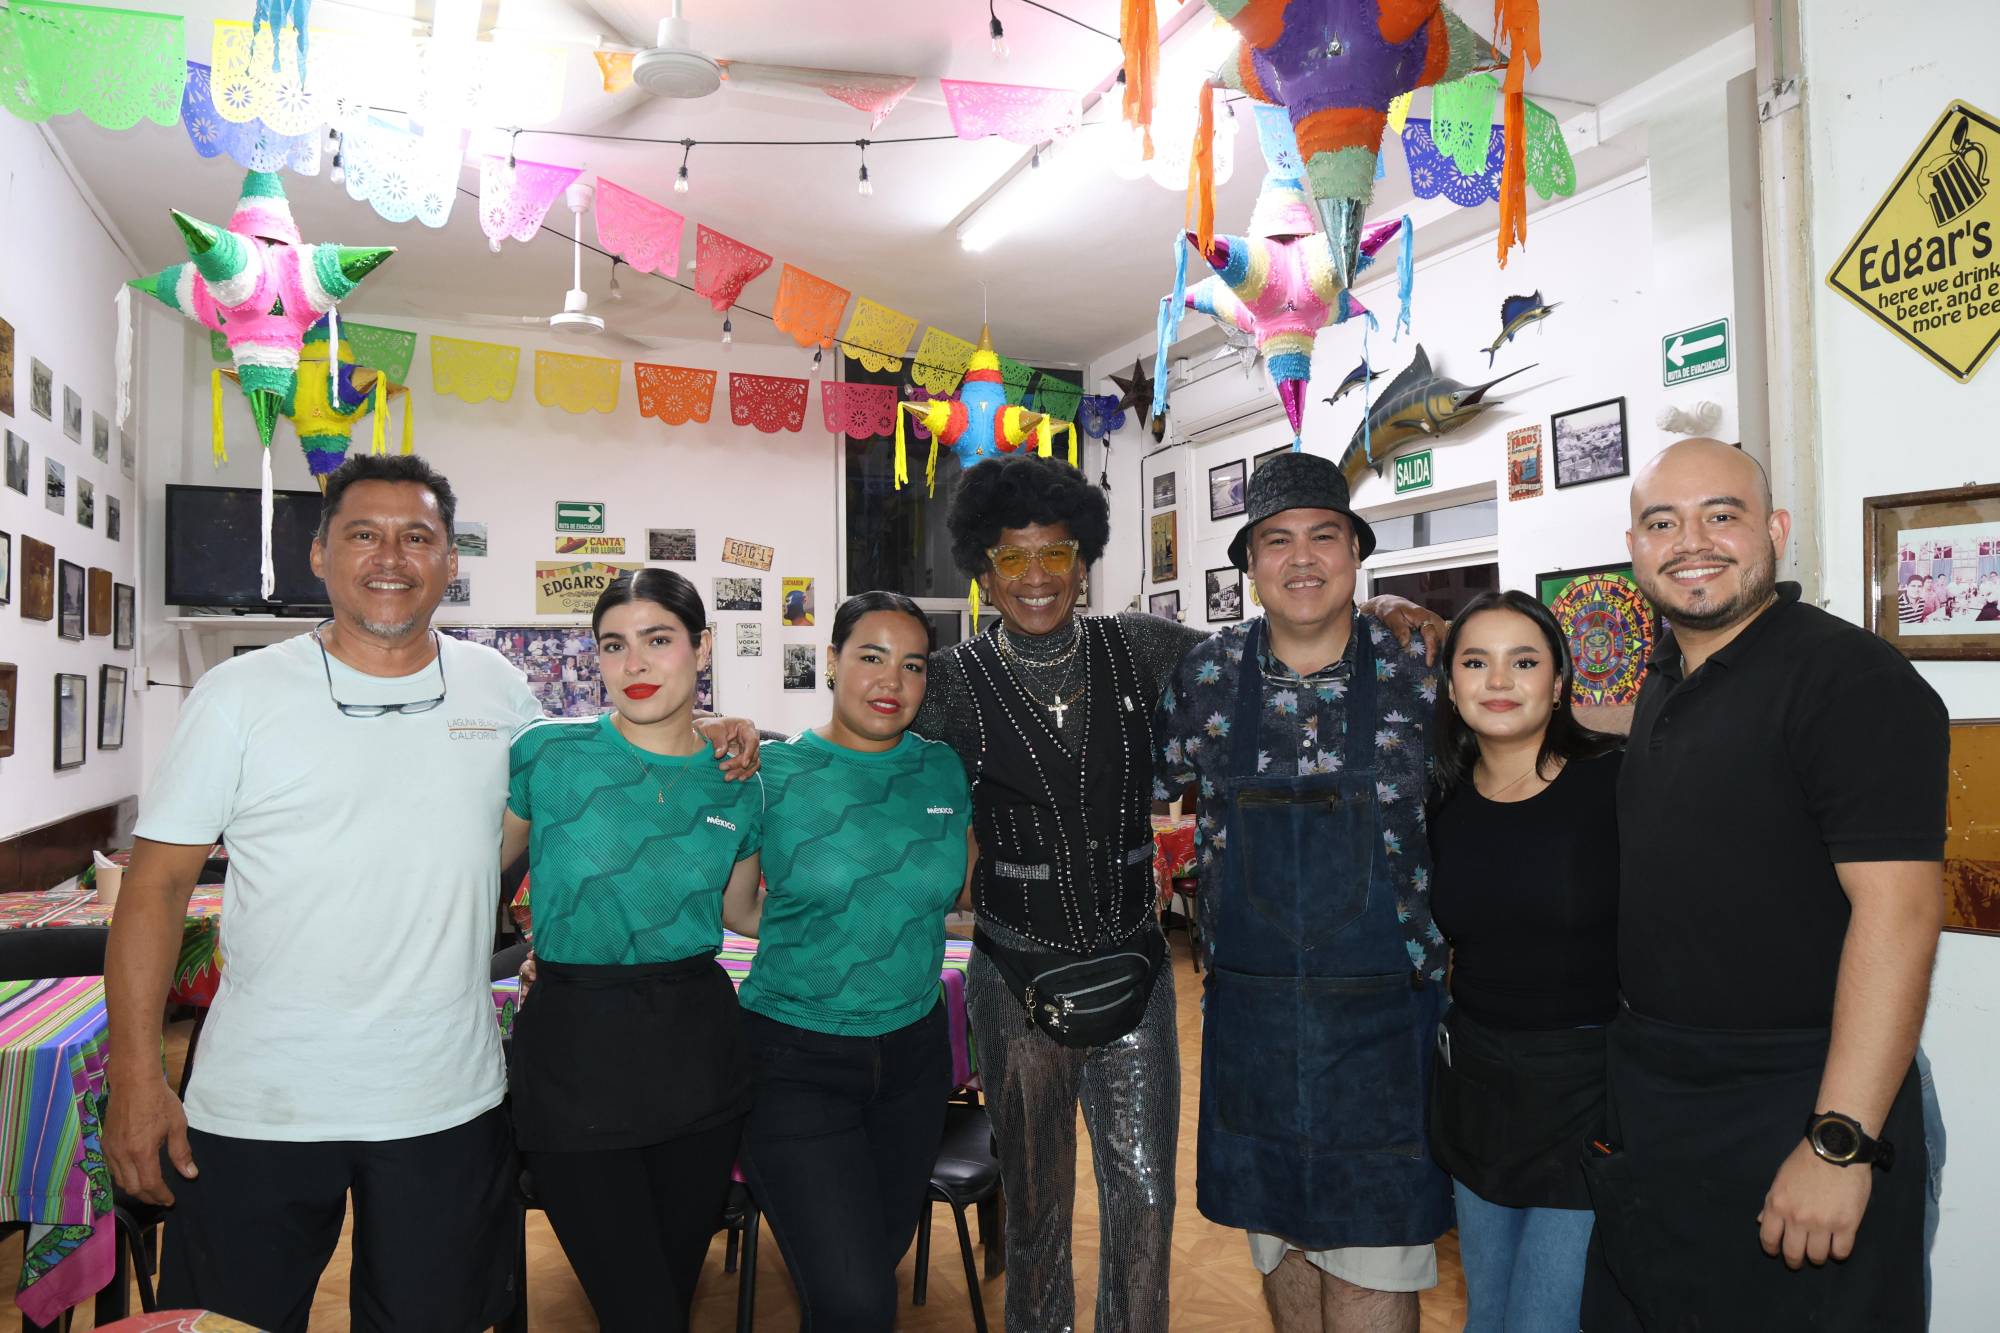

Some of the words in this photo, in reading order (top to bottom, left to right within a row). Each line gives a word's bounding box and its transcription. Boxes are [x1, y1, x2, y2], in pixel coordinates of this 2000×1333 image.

[1860, 220, 1992, 291] Edgar's
[1879, 287, 1918, 309] here
[1922, 279, 1948, 297] we
[1953, 261, 2000, 288] drink
[1896, 298, 1942, 321] beer,
[1946, 284, 1981, 308] and
[1913, 310, 1962, 333] more
[1967, 300, 2000, 320] bee
[1667, 369, 1682, 382] RUTA
[1682, 366, 1690, 378] DE
[1511, 433, 1538, 449] FAROS
[1397, 457, 1430, 487] SALIDA
[589, 537, 621, 546] CANTA
[542, 575, 605, 597] EDGAR'S
